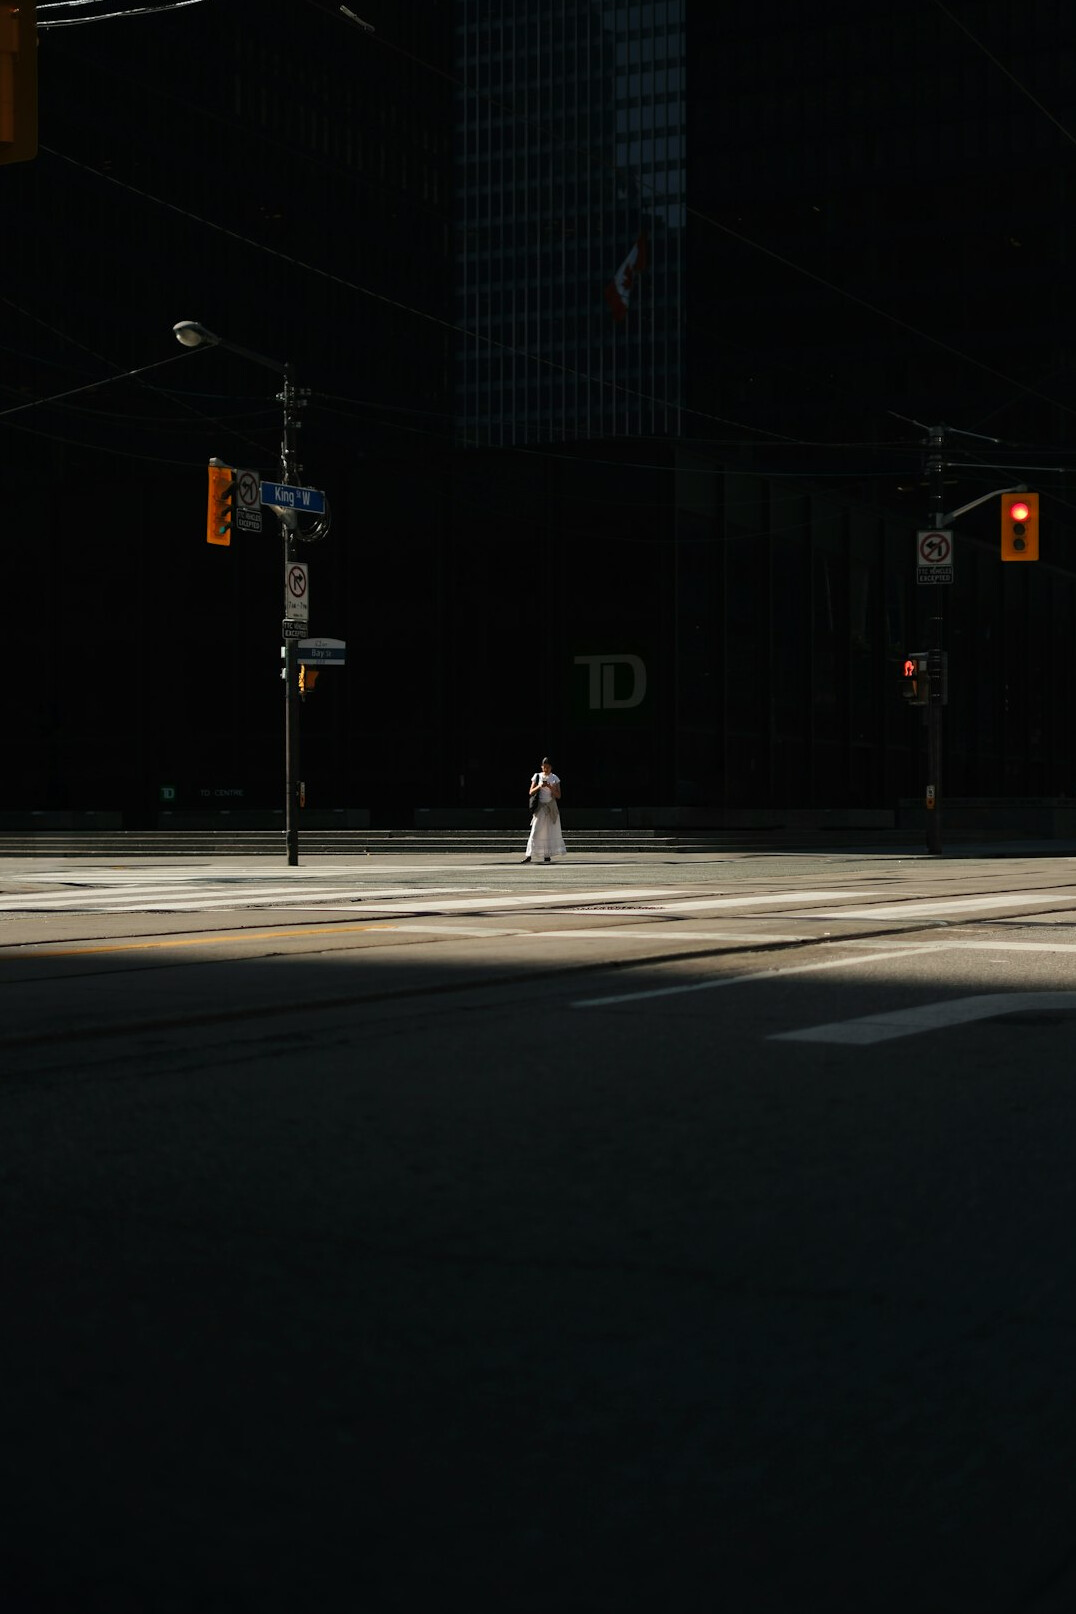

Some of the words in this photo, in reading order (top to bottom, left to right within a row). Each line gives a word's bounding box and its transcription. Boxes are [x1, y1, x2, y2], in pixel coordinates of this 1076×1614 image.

[275, 487, 294, 506] King
[302, 491, 310, 506] W
[312, 648, 324, 658] Bay
[574, 654, 647, 709] TD
[161, 788, 174, 798] TD
[214, 789, 244, 797] CENTRE
